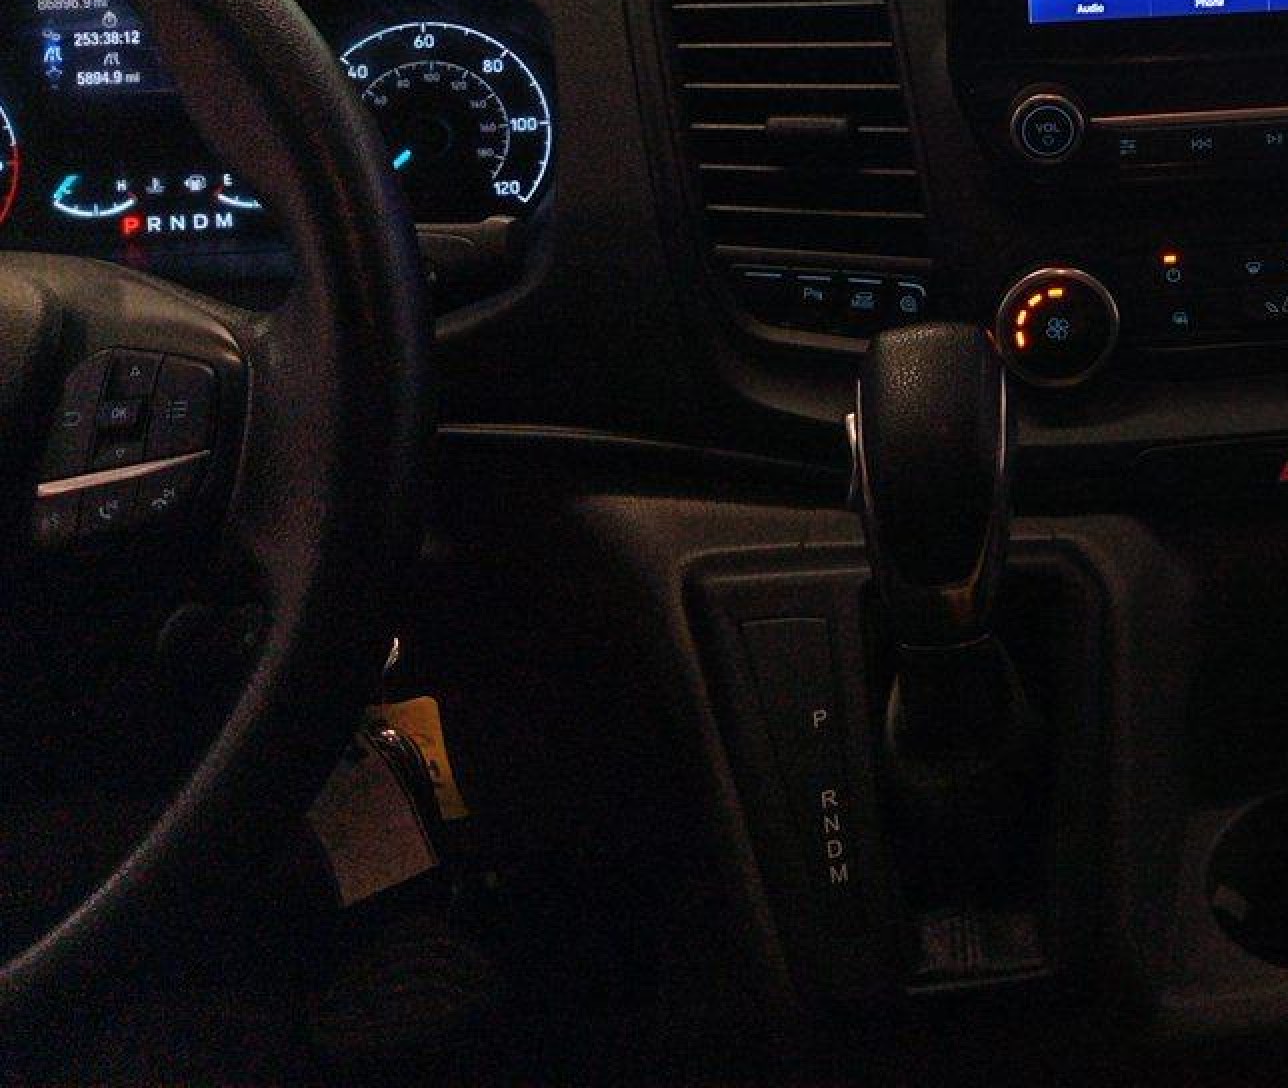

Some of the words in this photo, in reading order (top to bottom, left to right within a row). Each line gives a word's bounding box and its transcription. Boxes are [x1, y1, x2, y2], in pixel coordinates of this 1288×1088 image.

[1076, 3, 1105, 14] Audio
[73, 29, 141, 47] 253:38:12
[413, 33, 435, 49] 60
[482, 59, 504, 73] 80
[76, 70, 123, 86] 5894.9
[125, 71, 141, 83] mi
[509, 117, 538, 131] 100
[1035, 121, 1062, 134] VOL
[116, 179, 127, 192] H
[223, 173, 233, 187] E
[493, 179, 521, 196] 120
[122, 216, 142, 235] P
[148, 216, 162, 232] R
[170, 215, 185, 230] N
[194, 214, 208, 228] D
[215, 213, 234, 228] M
[813, 708, 827, 728] P
[821, 789, 839, 808] R
[823, 814, 841, 832] N
[827, 839, 843, 859] D
[829, 863, 849, 884] M
